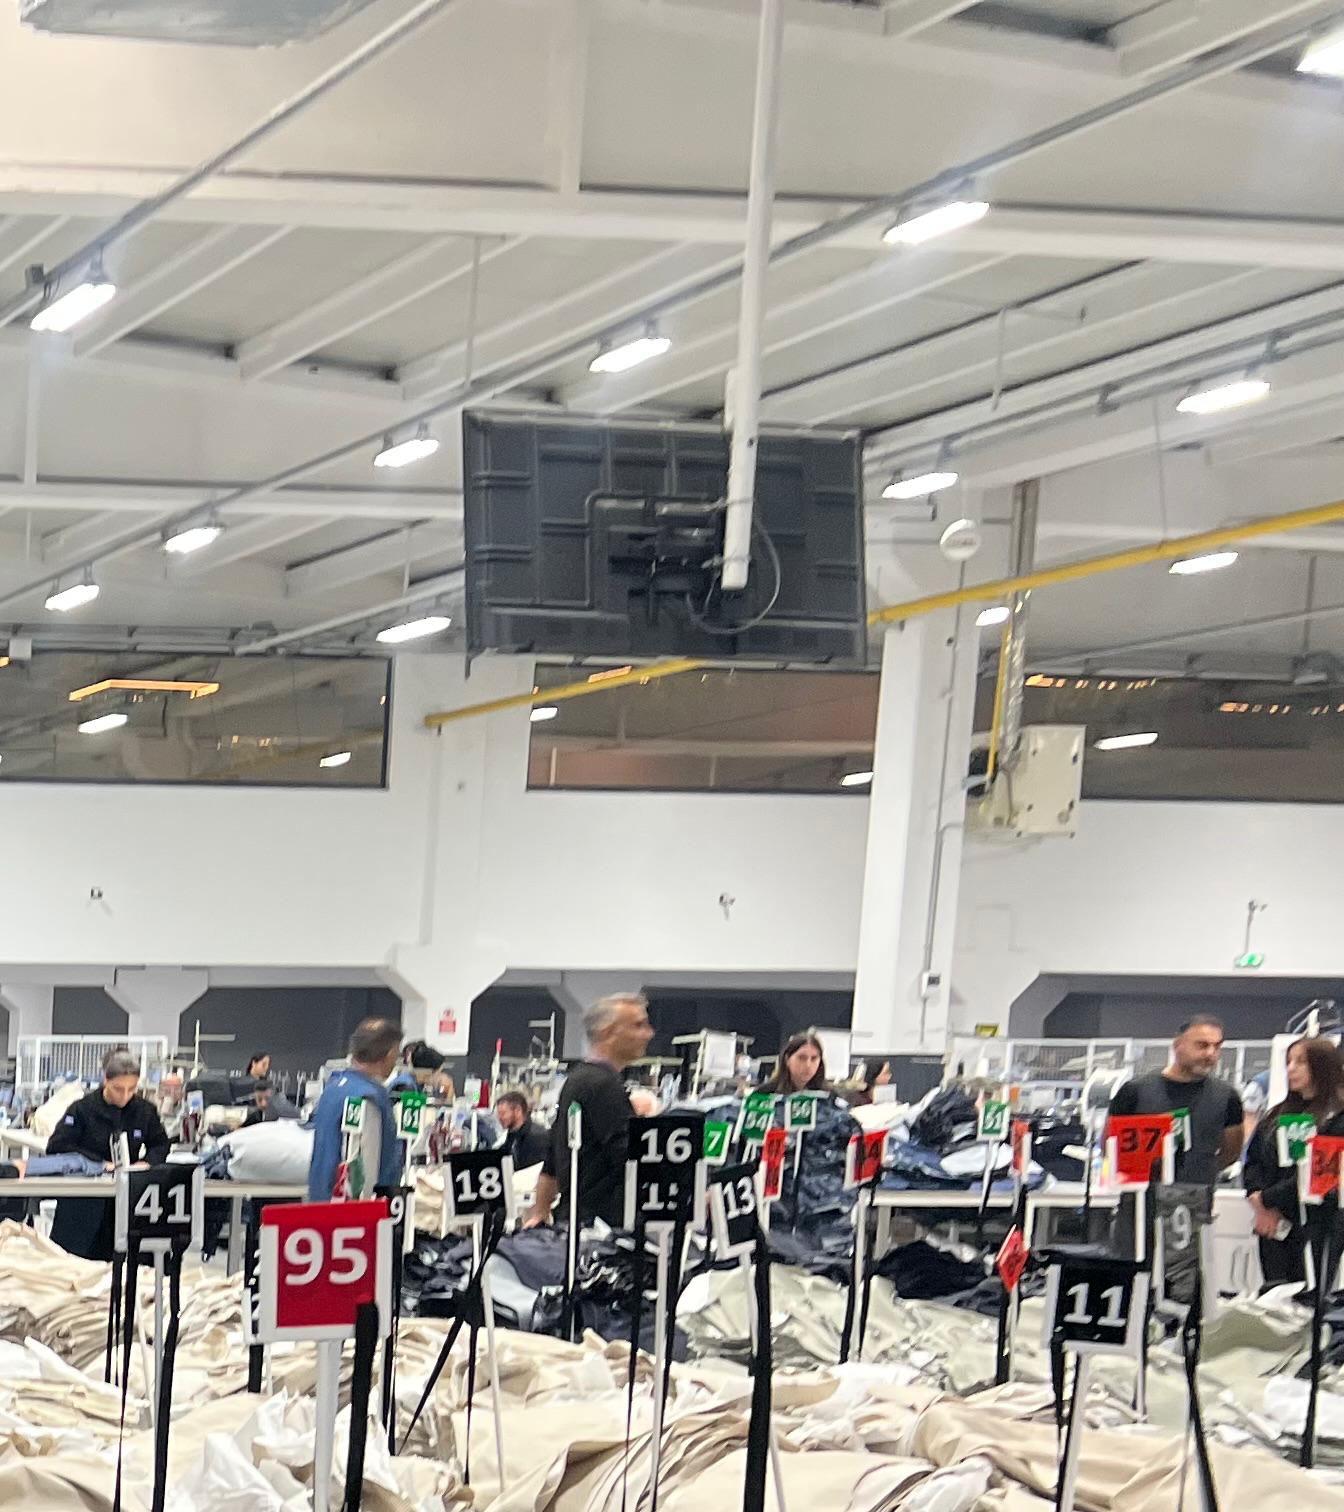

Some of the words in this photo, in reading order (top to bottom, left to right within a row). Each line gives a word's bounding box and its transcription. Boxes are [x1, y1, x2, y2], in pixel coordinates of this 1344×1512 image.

[640, 1127, 692, 1163] 16
[1120, 1128, 1161, 1152] 37
[134, 1184, 191, 1224] 41
[456, 1166, 503, 1201] 18
[723, 1176, 755, 1220] 13
[1172, 1204, 1191, 1250] 9
[284, 1226, 368, 1285] 95
[1063, 1283, 1127, 1326] 11
